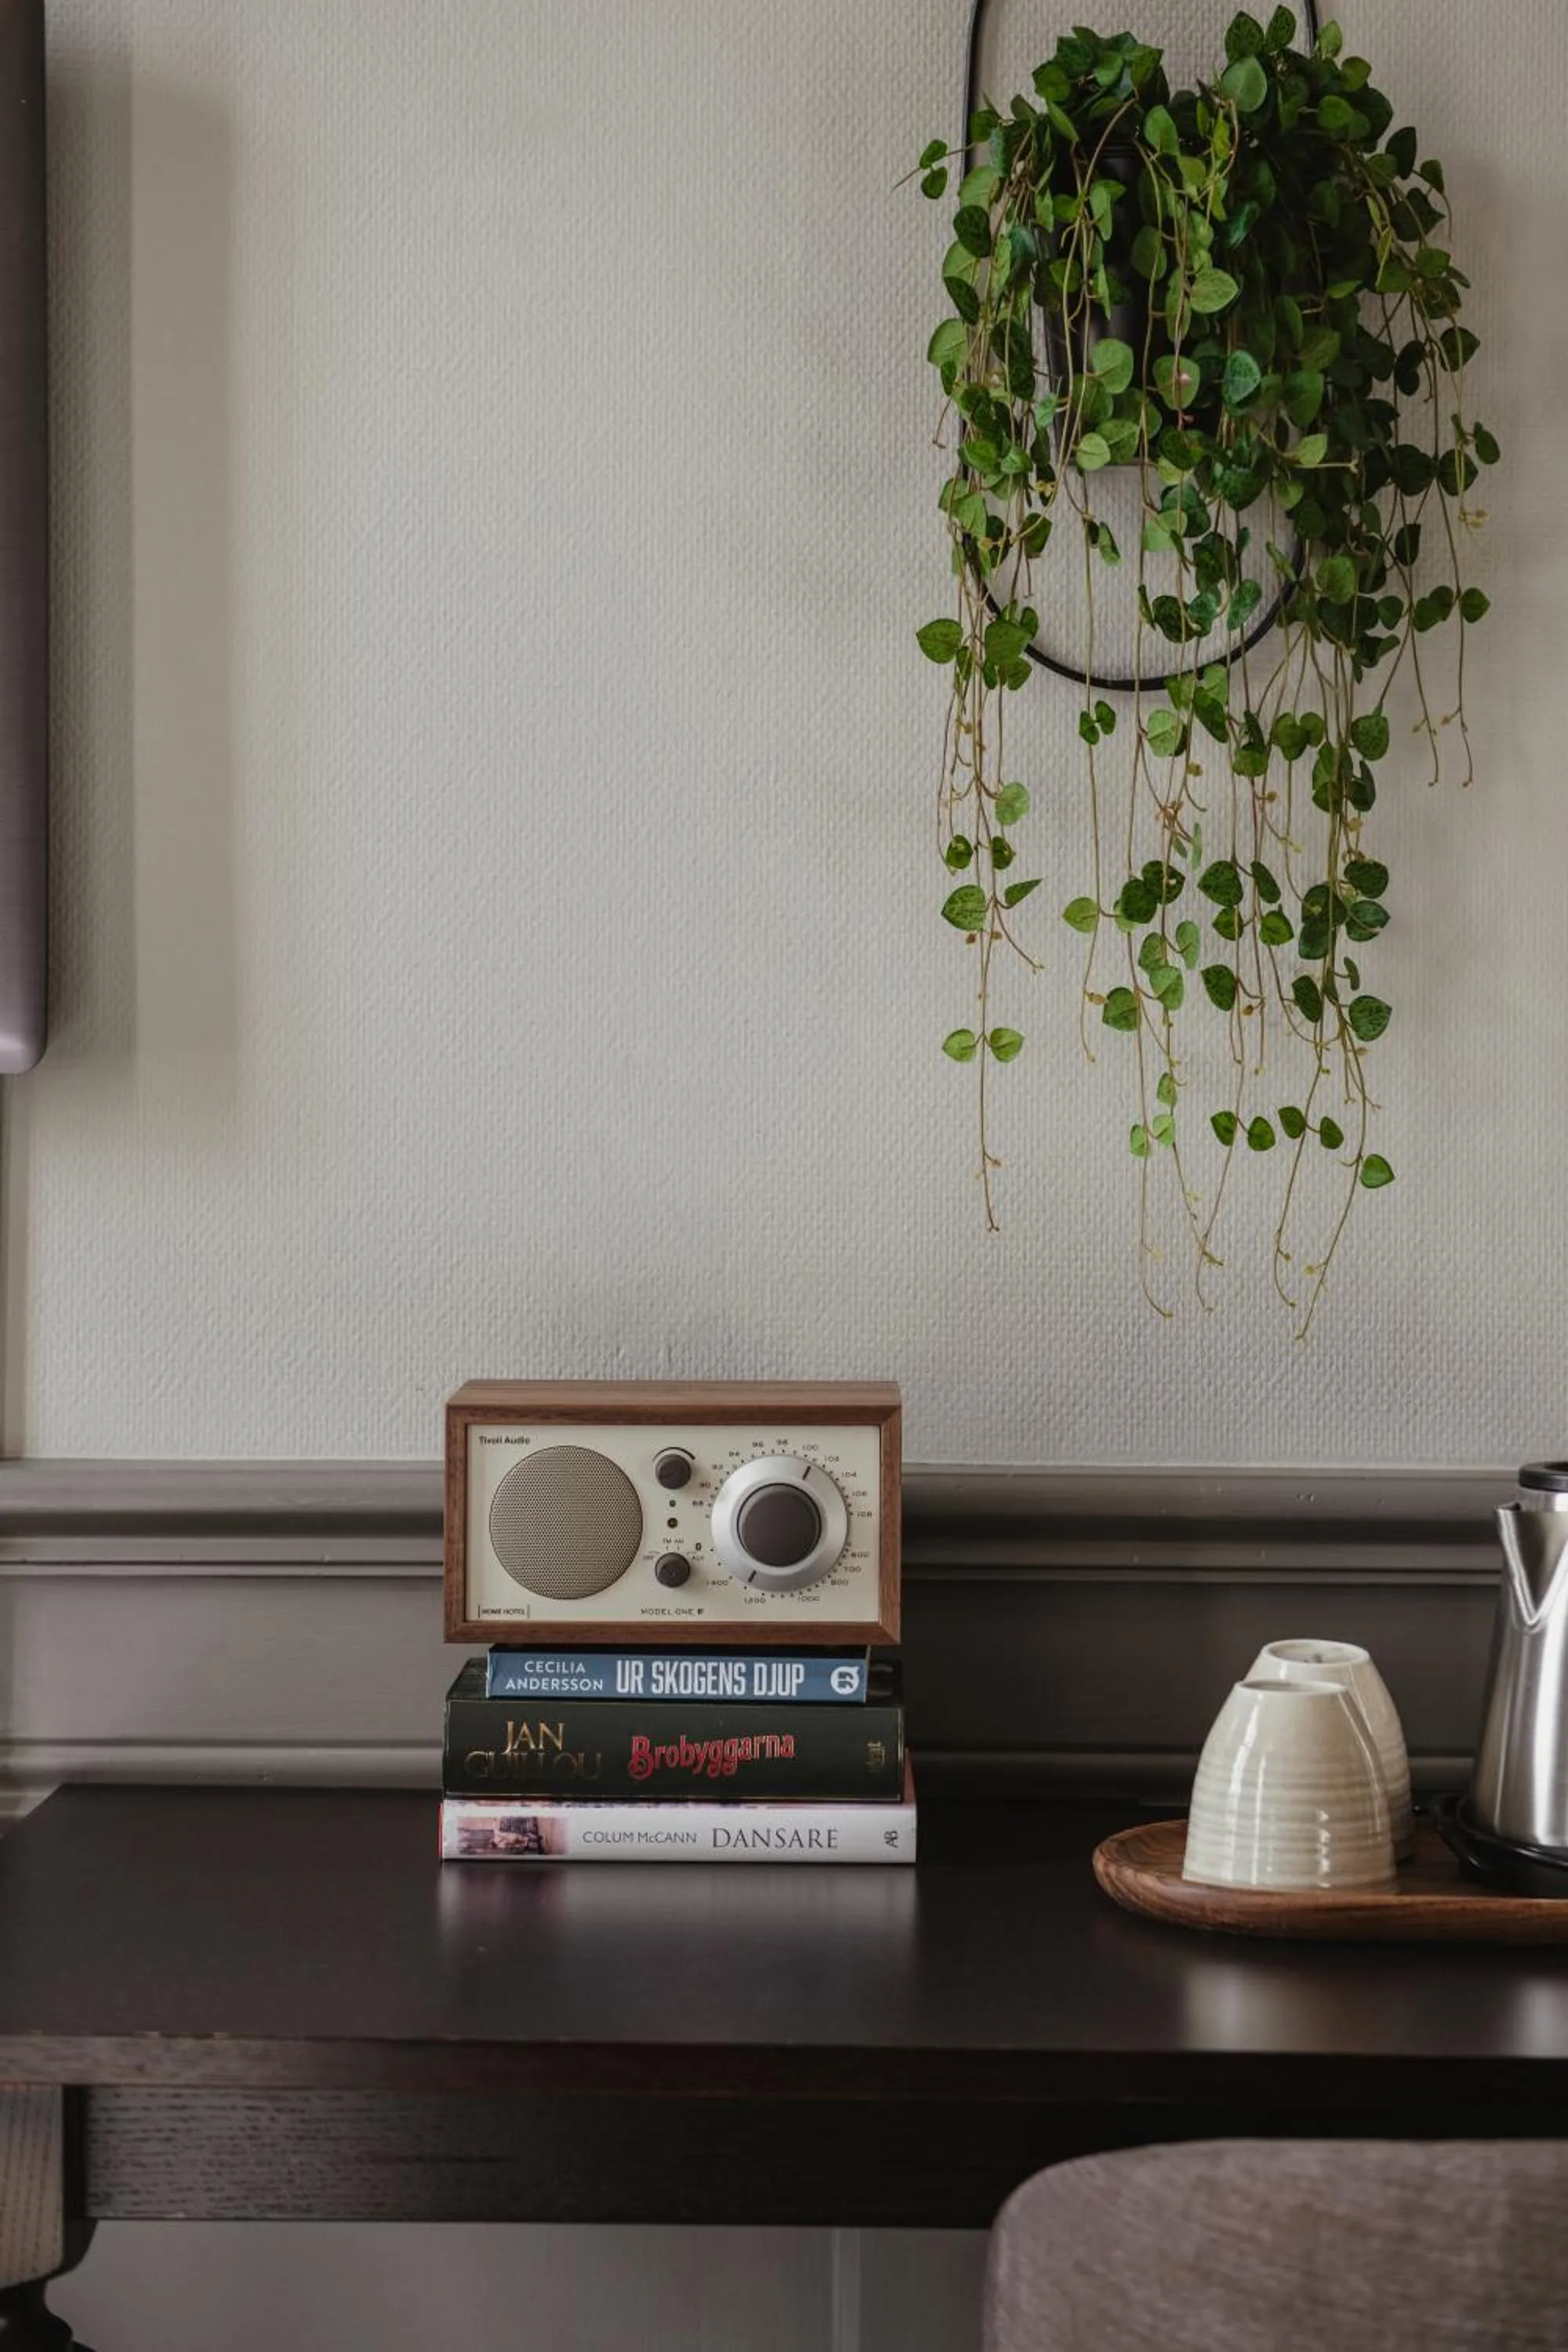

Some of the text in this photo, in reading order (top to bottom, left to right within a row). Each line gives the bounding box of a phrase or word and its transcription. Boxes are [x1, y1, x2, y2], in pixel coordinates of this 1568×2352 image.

[504, 1436, 531, 1444] Audio
[524, 1661, 586, 1673] CECILIA
[505, 1677, 604, 1690] ANDERSSON
[616, 1660, 805, 1697] UR SKOGENS DJUP
[502, 1721, 564, 1755] JAN
[628, 1734, 797, 1780] Brobyggarna
[583, 1827, 839, 1849] COLUM McCANN DANSARE
